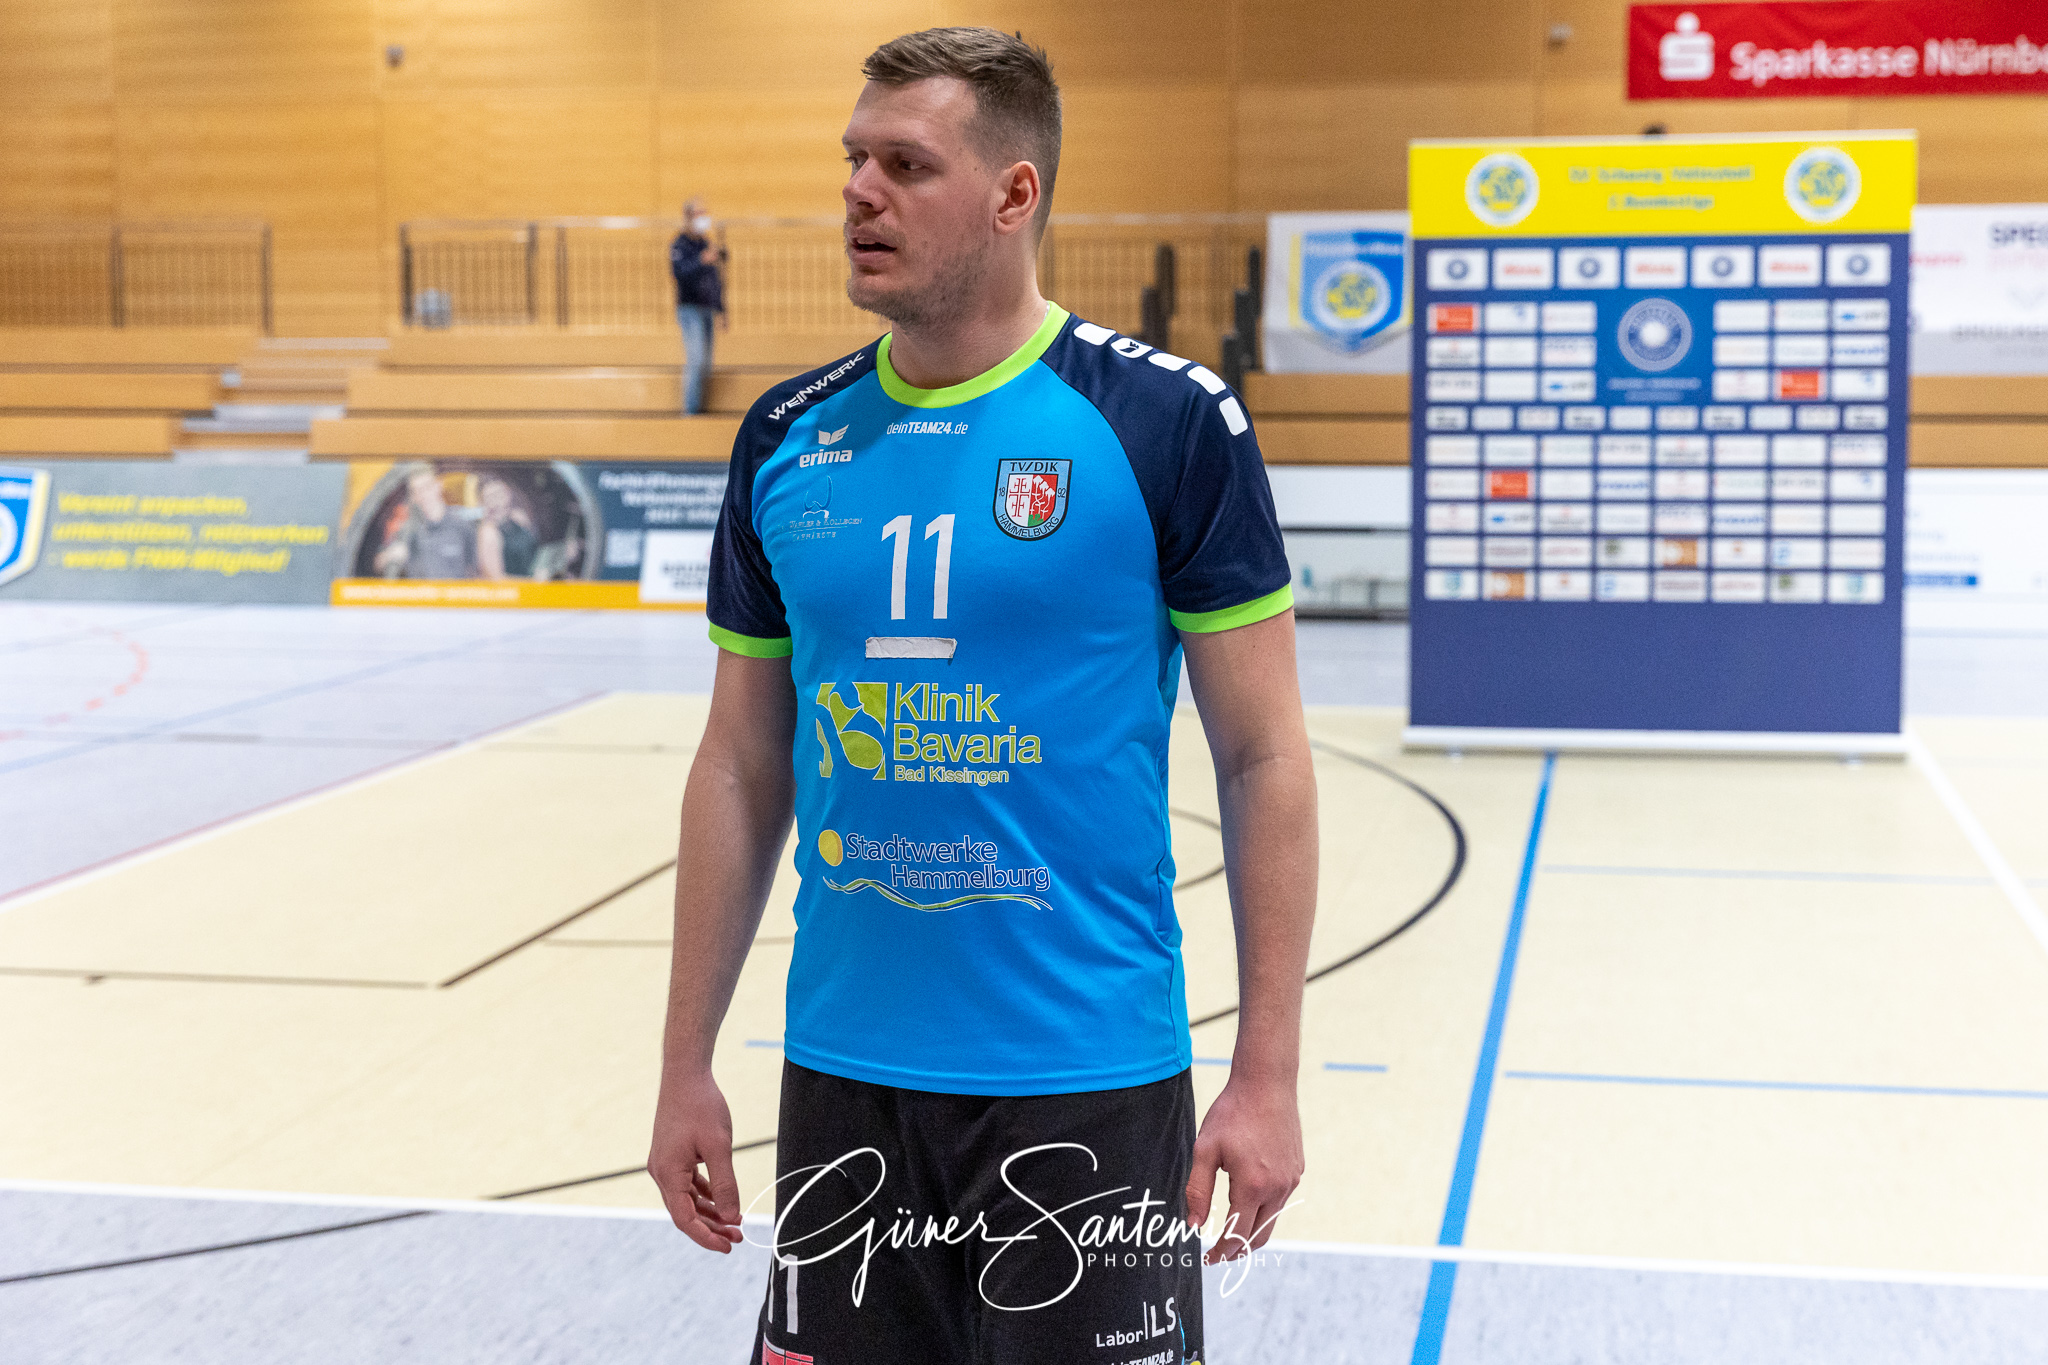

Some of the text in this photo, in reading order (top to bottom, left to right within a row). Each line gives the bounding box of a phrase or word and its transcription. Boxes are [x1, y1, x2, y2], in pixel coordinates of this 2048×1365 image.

[1729, 40, 1919, 87] Sparkasse
[767, 352, 865, 421] WEINWERK
[886, 421, 968, 436] deinTEAM24.de
[799, 449, 853, 469] erima
[1010, 461, 1058, 474] TV/DJK
[998, 486, 1006, 498] 18
[1057, 487, 1067, 499] 92
[998, 513, 1060, 538] HAMMELBURG
[881, 513, 956, 620] 11
[894, 682, 1000, 722] Klinik
[893, 722, 1042, 764] Bavaria
[894, 765, 1010, 787] Bad Kissingen
[846, 832, 998, 863] Stadtwerke
[891, 863, 1051, 892] Hammelburg
[1096, 1330, 1144, 1347] Labor
